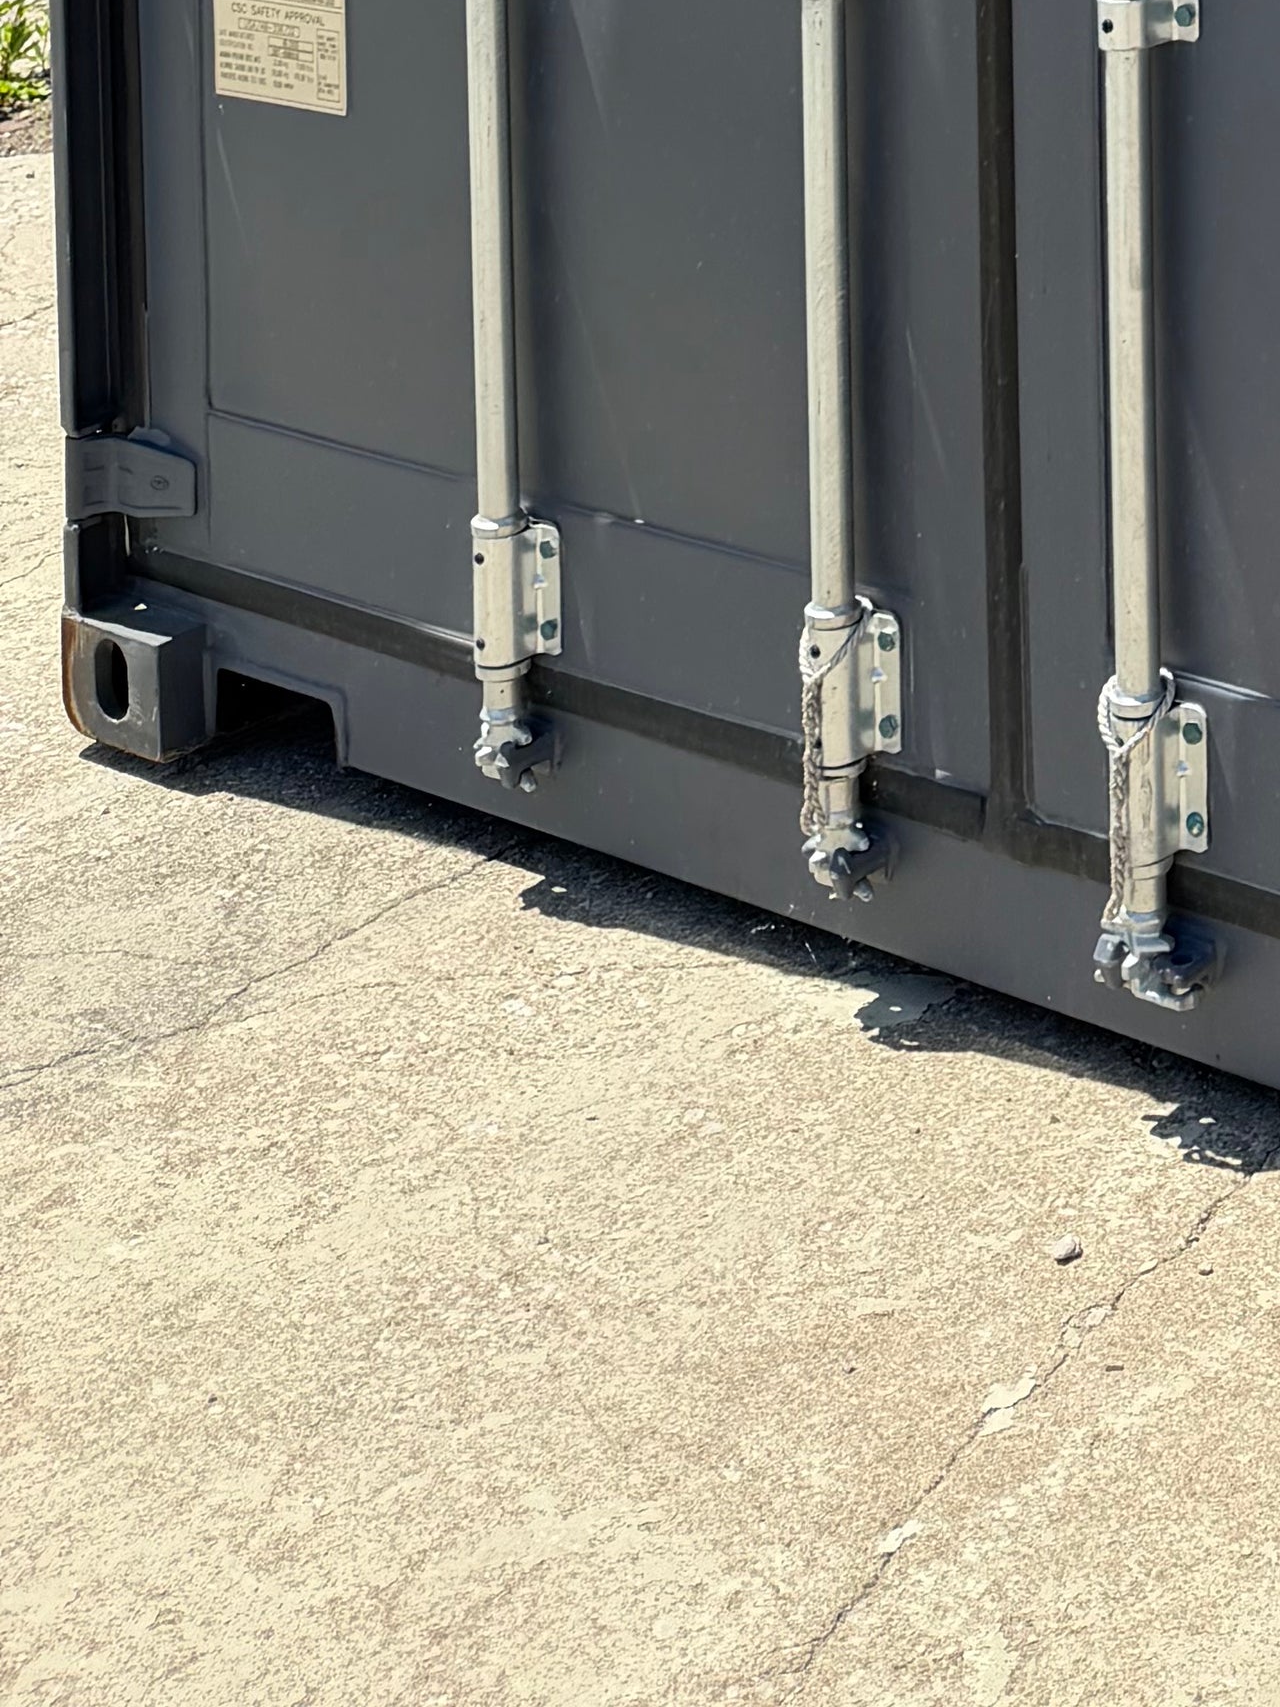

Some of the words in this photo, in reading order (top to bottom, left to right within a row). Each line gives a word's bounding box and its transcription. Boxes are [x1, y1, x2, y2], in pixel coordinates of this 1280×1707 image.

[231, 1, 247, 14] CSC
[251, 4, 281, 19] SAFETY
[285, 10, 326, 27] APPROVAL
